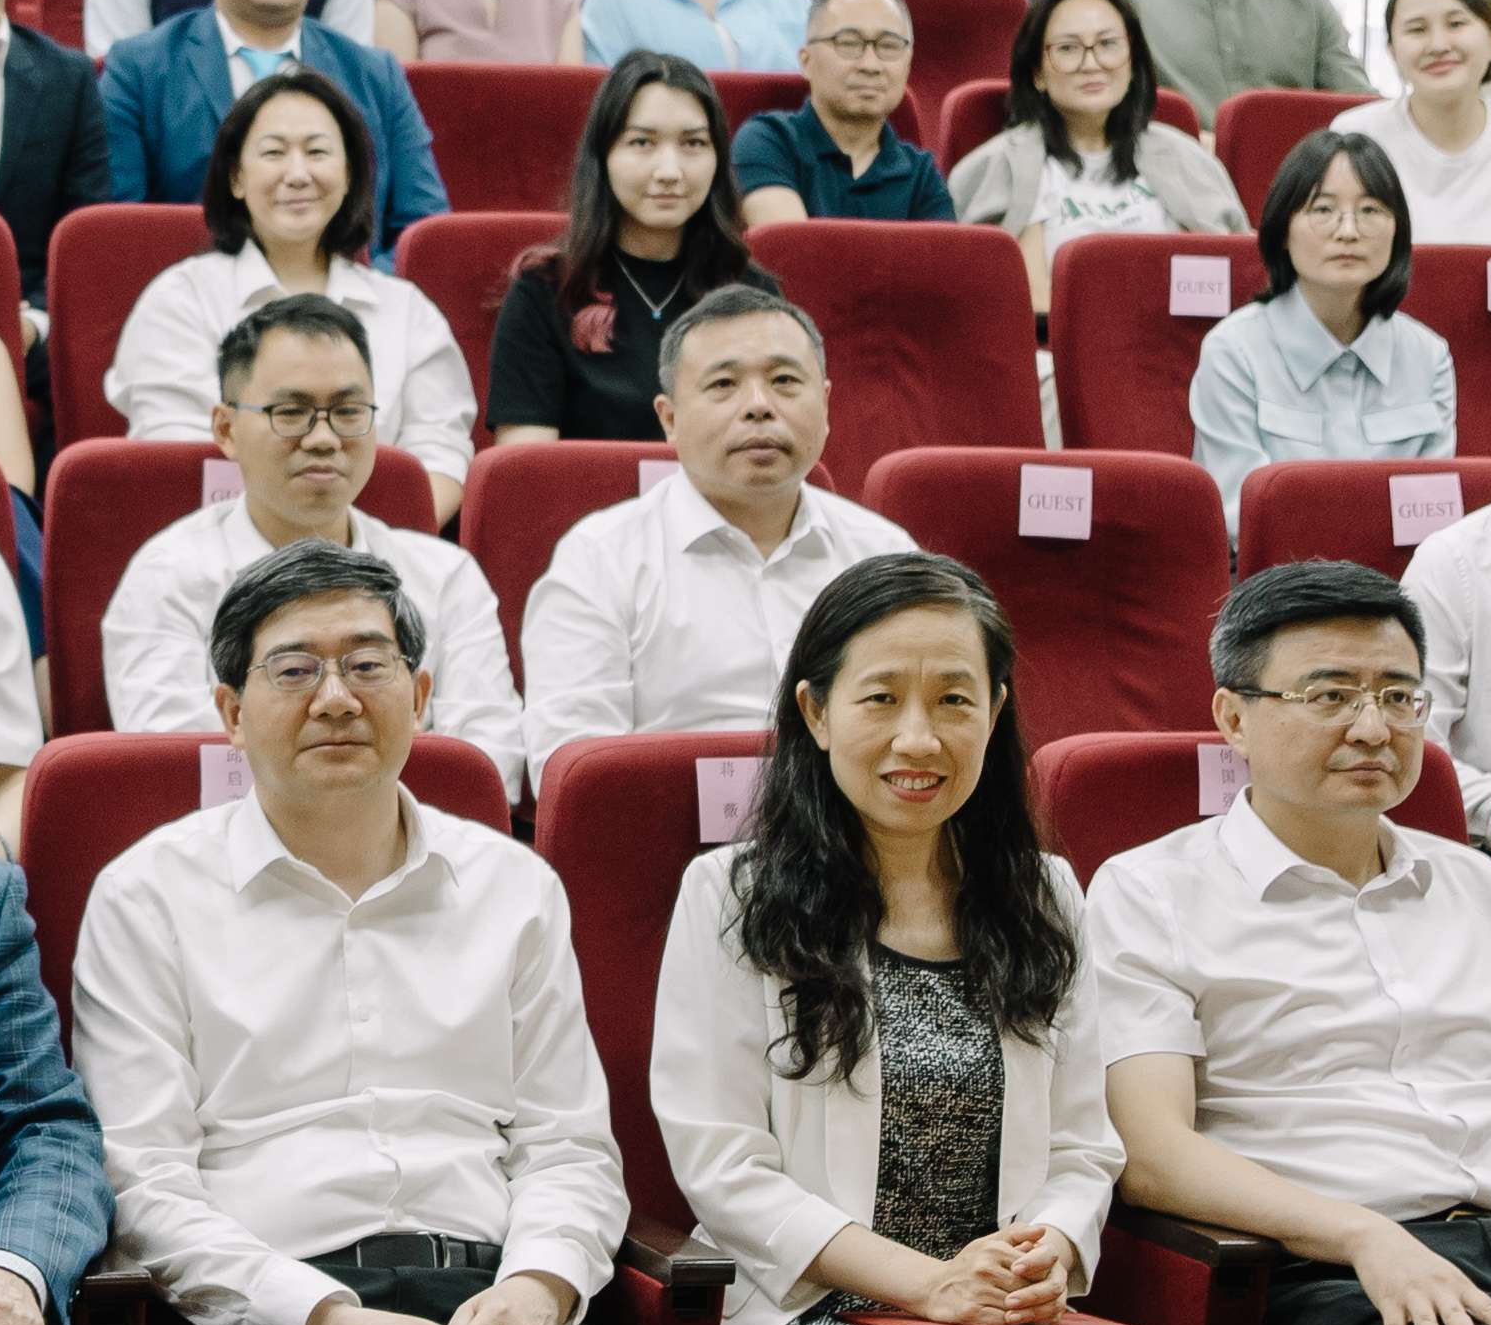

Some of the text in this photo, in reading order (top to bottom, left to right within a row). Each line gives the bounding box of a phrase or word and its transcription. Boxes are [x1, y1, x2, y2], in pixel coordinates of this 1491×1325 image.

[1176, 280, 1225, 295] GUEST
[1027, 493, 1084, 512] GUEST
[1398, 501, 1456, 519] GUEST
